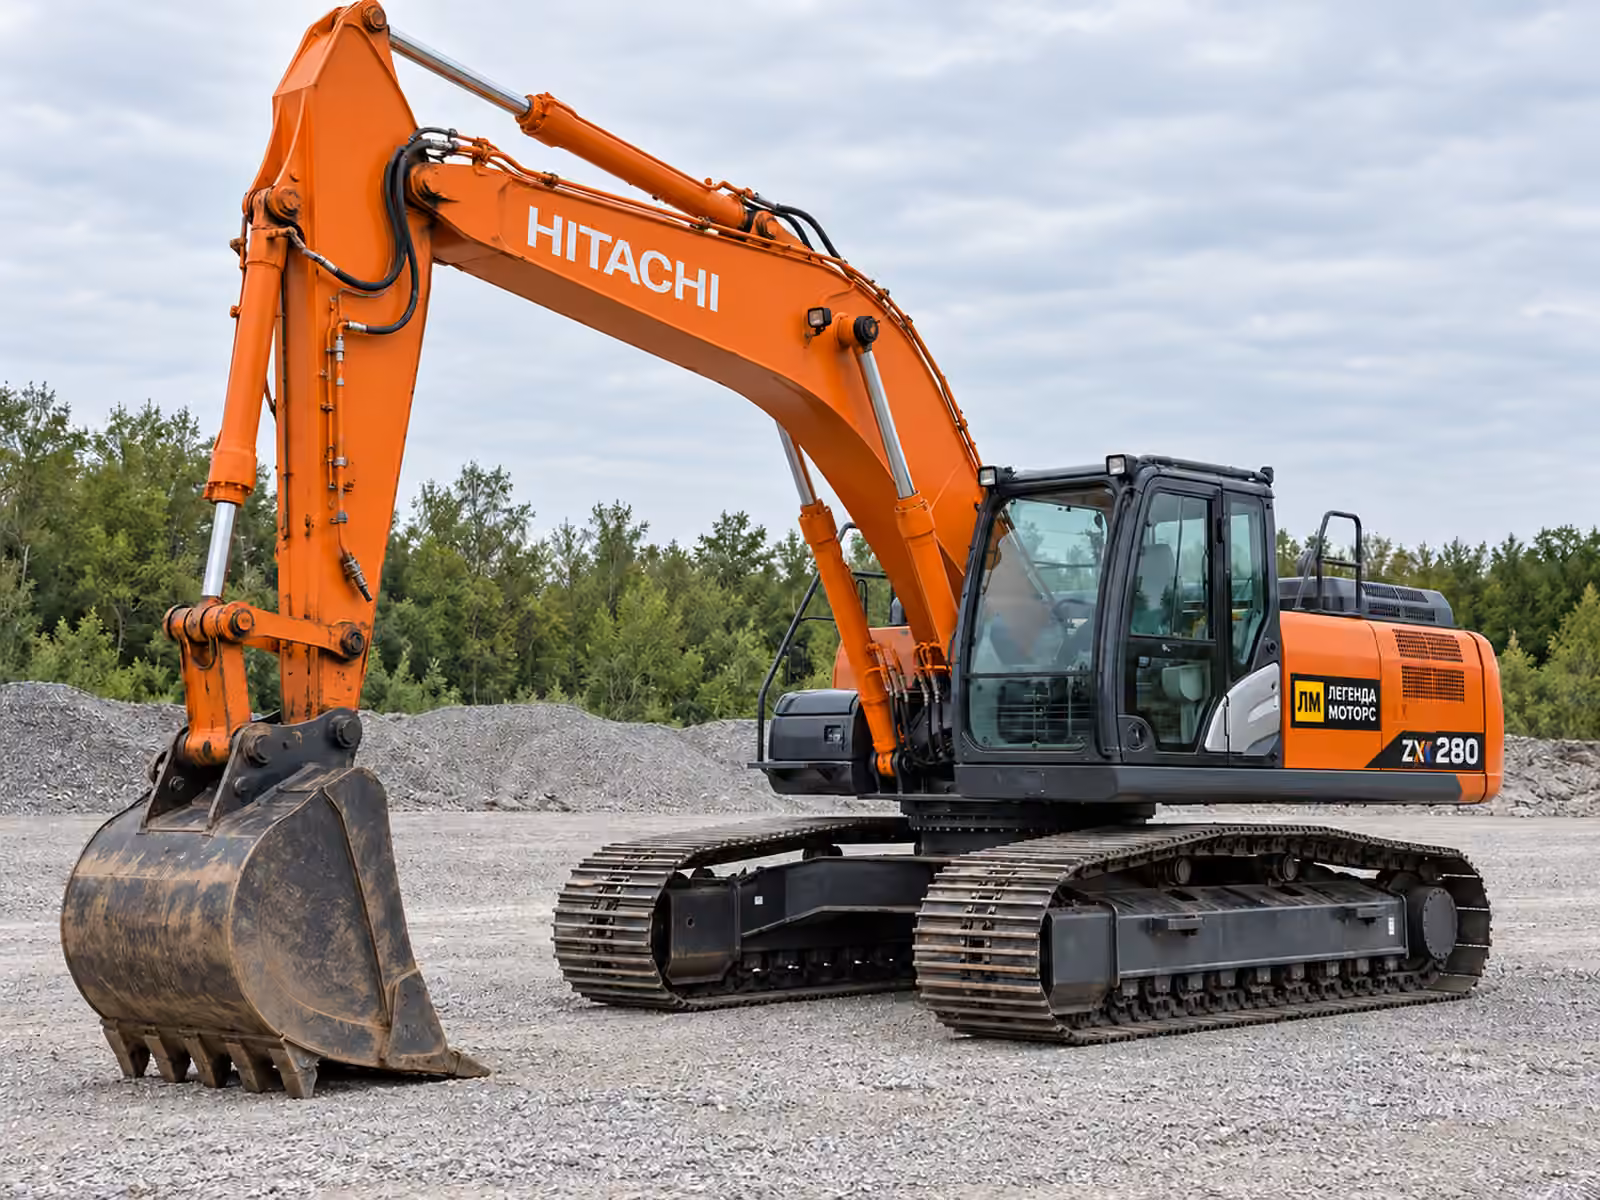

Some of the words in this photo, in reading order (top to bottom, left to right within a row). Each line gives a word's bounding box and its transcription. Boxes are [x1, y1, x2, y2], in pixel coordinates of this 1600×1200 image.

[527, 205, 720, 313] HITACHI
[1297, 691, 1321, 713] ЛМ
[1328, 685, 1377, 706] ЛЕГЕНДА
[1328, 705, 1377, 721] МОТОРС
